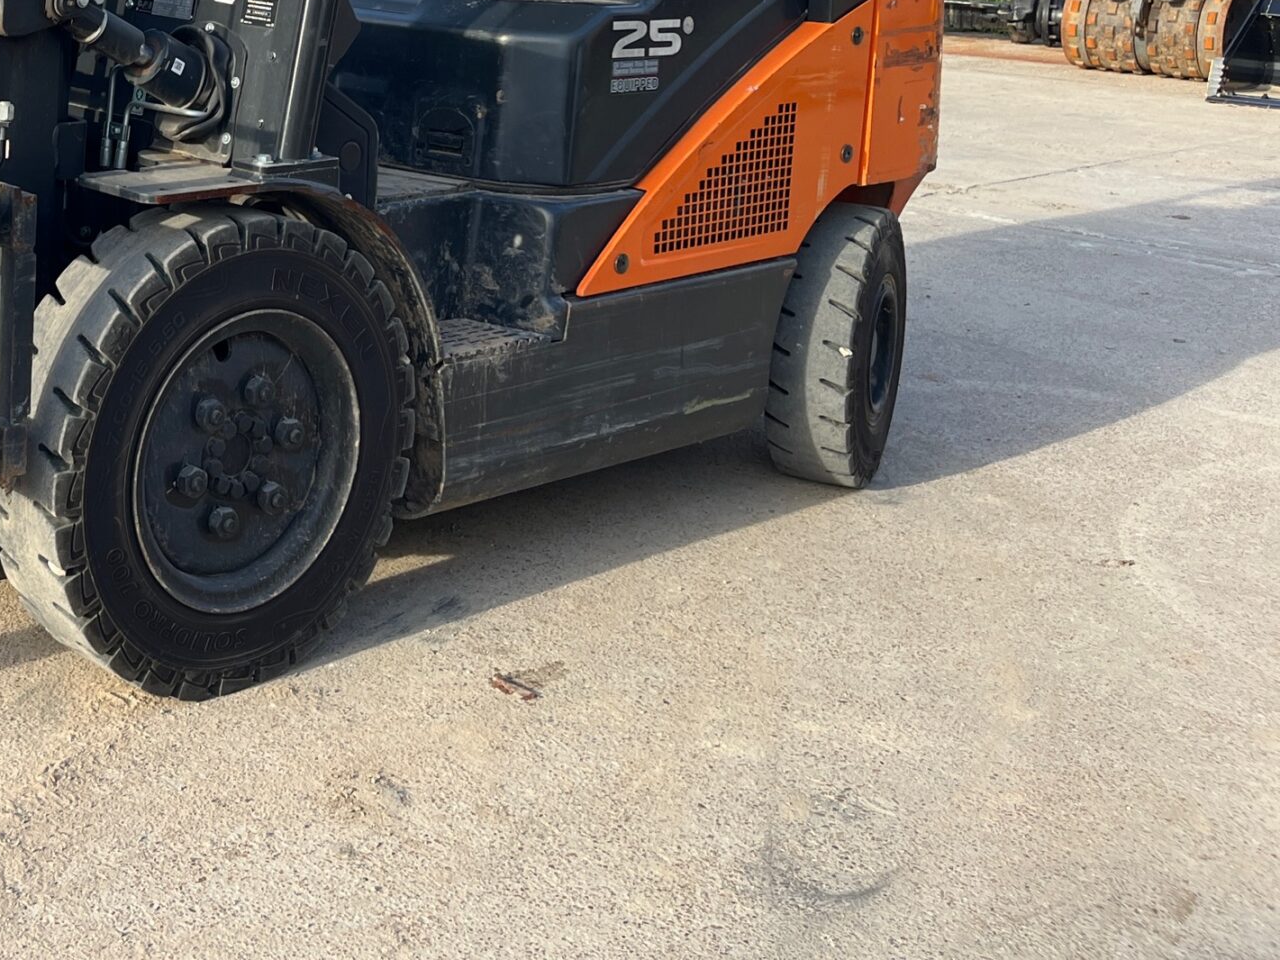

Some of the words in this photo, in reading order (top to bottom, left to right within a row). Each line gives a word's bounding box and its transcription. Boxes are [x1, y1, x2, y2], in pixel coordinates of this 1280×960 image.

[610, 77, 659, 93] EQUIPPED
[271, 266, 375, 365] NEXEN
[132, 596, 249, 650] SOLIDPRO
